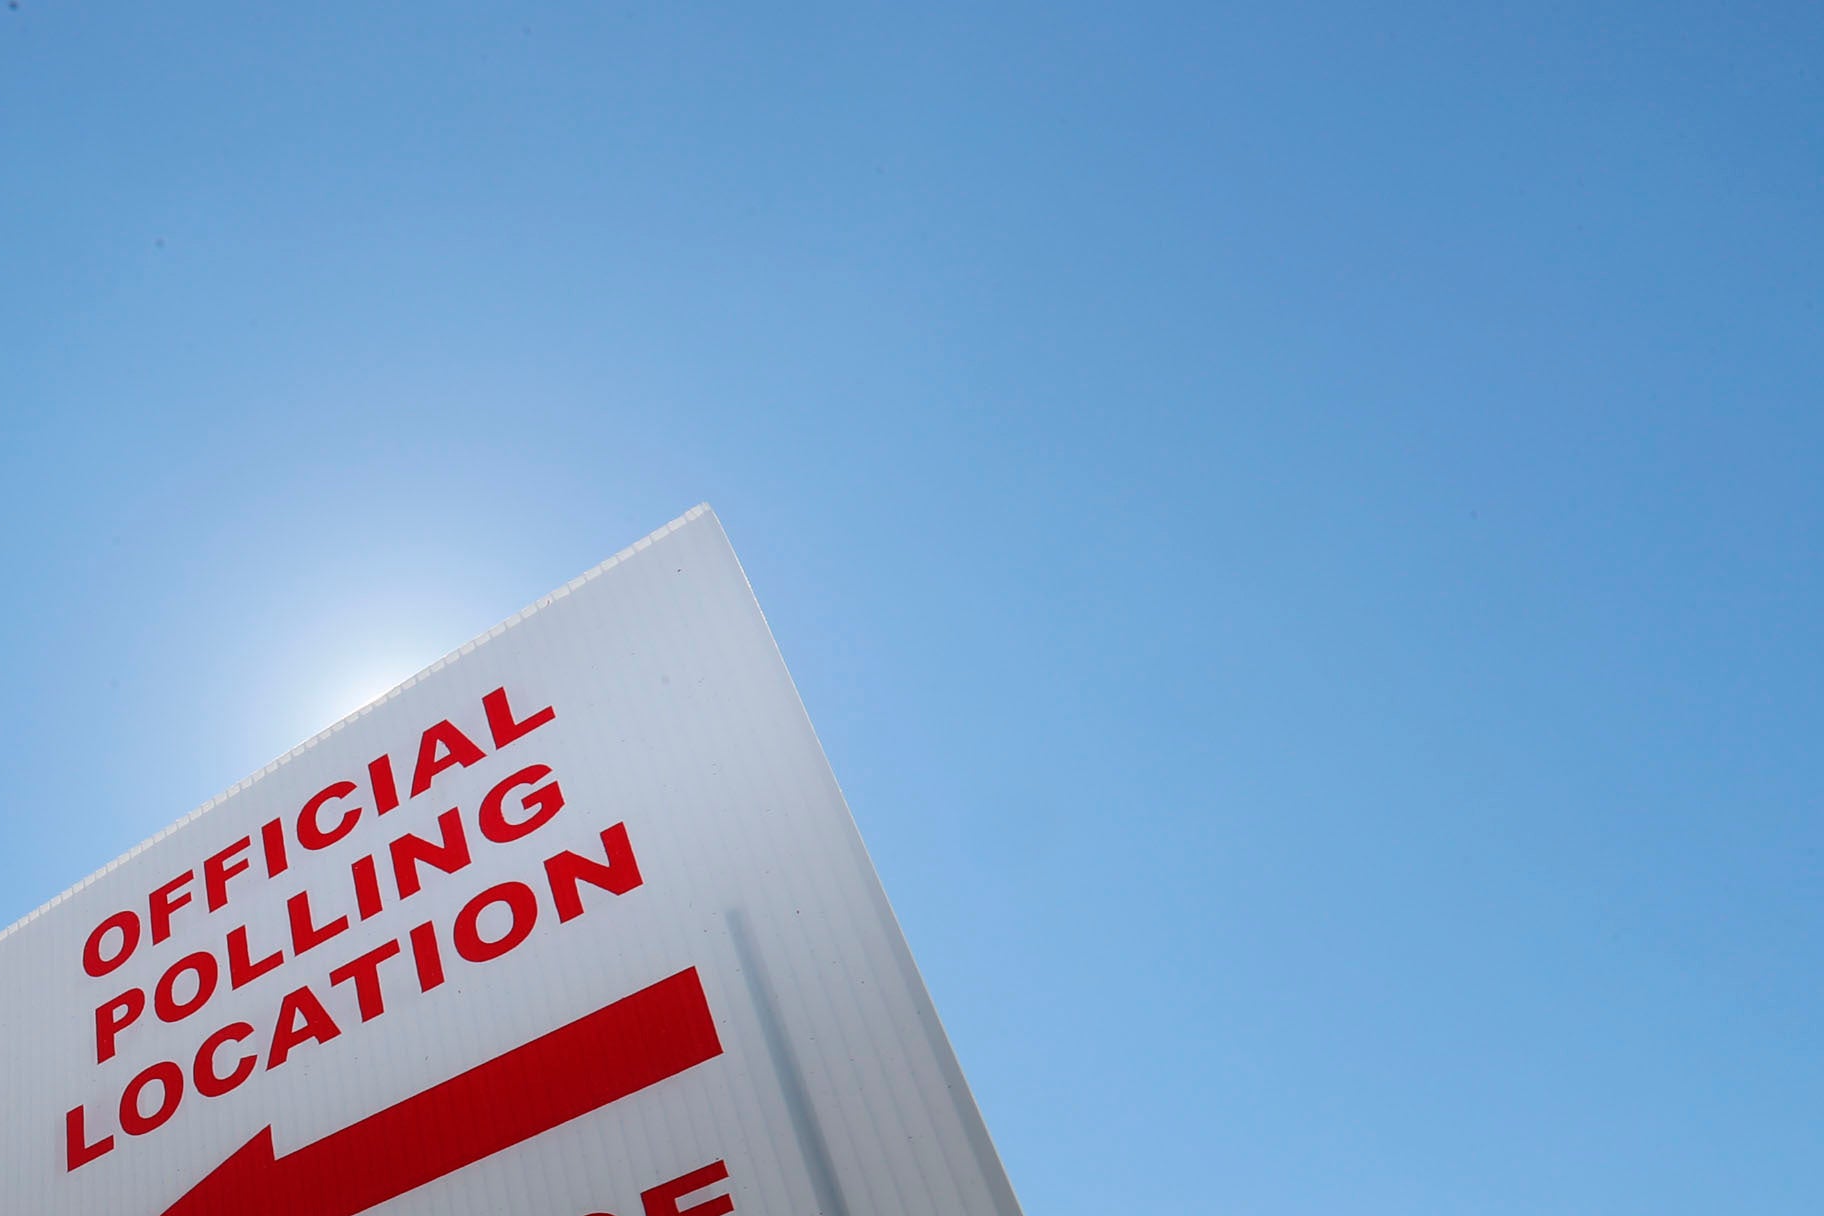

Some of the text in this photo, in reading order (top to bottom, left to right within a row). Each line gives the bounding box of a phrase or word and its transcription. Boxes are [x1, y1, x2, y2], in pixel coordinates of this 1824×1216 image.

[84, 688, 556, 976] OFFICIAL
[96, 764, 565, 1063] POLLING
[67, 823, 643, 1170] LOCATION
